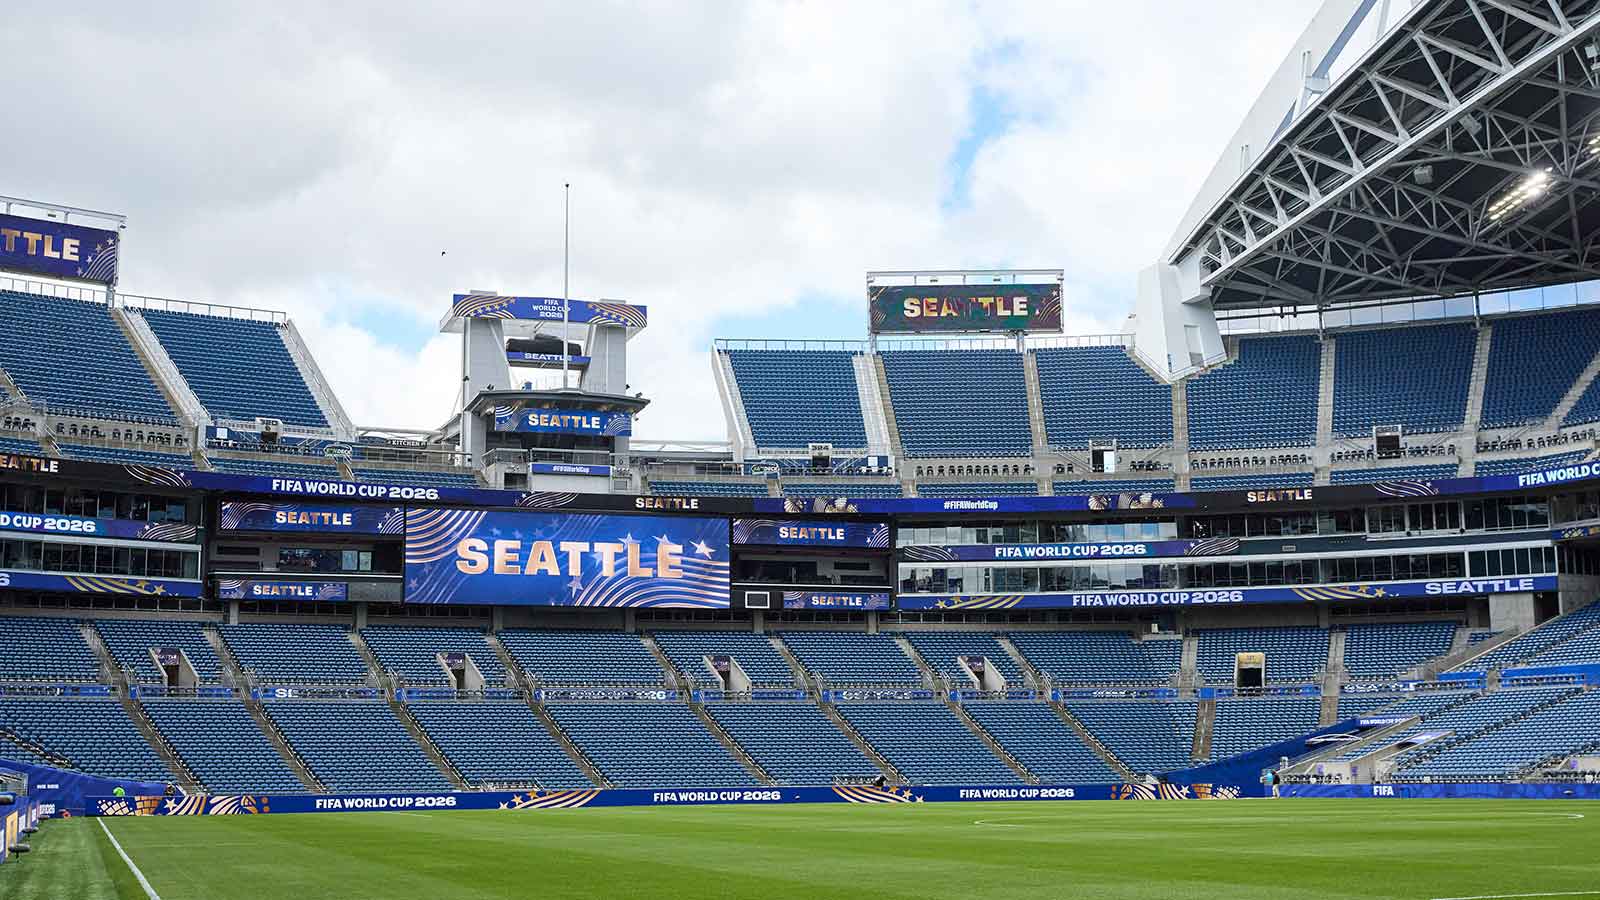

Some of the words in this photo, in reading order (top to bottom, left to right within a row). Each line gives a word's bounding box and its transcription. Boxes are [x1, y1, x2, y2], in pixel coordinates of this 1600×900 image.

[903, 296, 1028, 317] SEATTLE
[539, 311, 563, 319] 2026
[528, 413, 601, 429] SEATTLE
[1518, 473, 1546, 487] FIFA
[1546, 465, 1590, 482] WORLD
[272, 479, 303, 493] FIFA
[304, 481, 357, 496] WORLD
[358, 485, 387, 497] CUP
[388, 487, 439, 500] 2026
[1247, 489, 1312, 503] SEATTLE
[635, 497, 699, 509] SEATTLE
[943, 500, 998, 511] #FIFAWorldCup
[12, 515, 41, 529] CUP
[44, 518, 96, 532] 2026
[275, 511, 352, 525] SEATTLE
[779, 526, 845, 540] SEATTLE
[995, 547, 1023, 557] FIFA
[1023, 545, 1071, 557] WORLD
[1073, 545, 1099, 556] CUP
[1100, 544, 1146, 555] 2026
[455, 538, 684, 579] SEATTLE
[253, 585, 313, 597] SEATTLE
[1425, 579, 1535, 594] SEATTLE
[811, 596, 862, 606] SEATTLE
[1072, 594, 1104, 606] FIFA
[1104, 593, 1158, 606] WORLD
[1160, 591, 1190, 604] CUP
[1191, 590, 1243, 603] 2026
[653, 792, 678, 802] FIFA
[678, 791, 718, 801] WORLD
[720, 791, 742, 801] CUP
[743, 791, 781, 801] 2026
[960, 789, 981, 798] FIFA
[982, 789, 1018, 798] WORLD
[1019, 789, 1041, 798] CUP
[1040, 788, 1074, 797] 2026
[1373, 785, 1394, 796] FIFA
[316, 799, 343, 808] FIFA
[343, 798, 387, 808] WORLD
[389, 797, 413, 807] CUP
[415, 796, 457, 807] 2026
